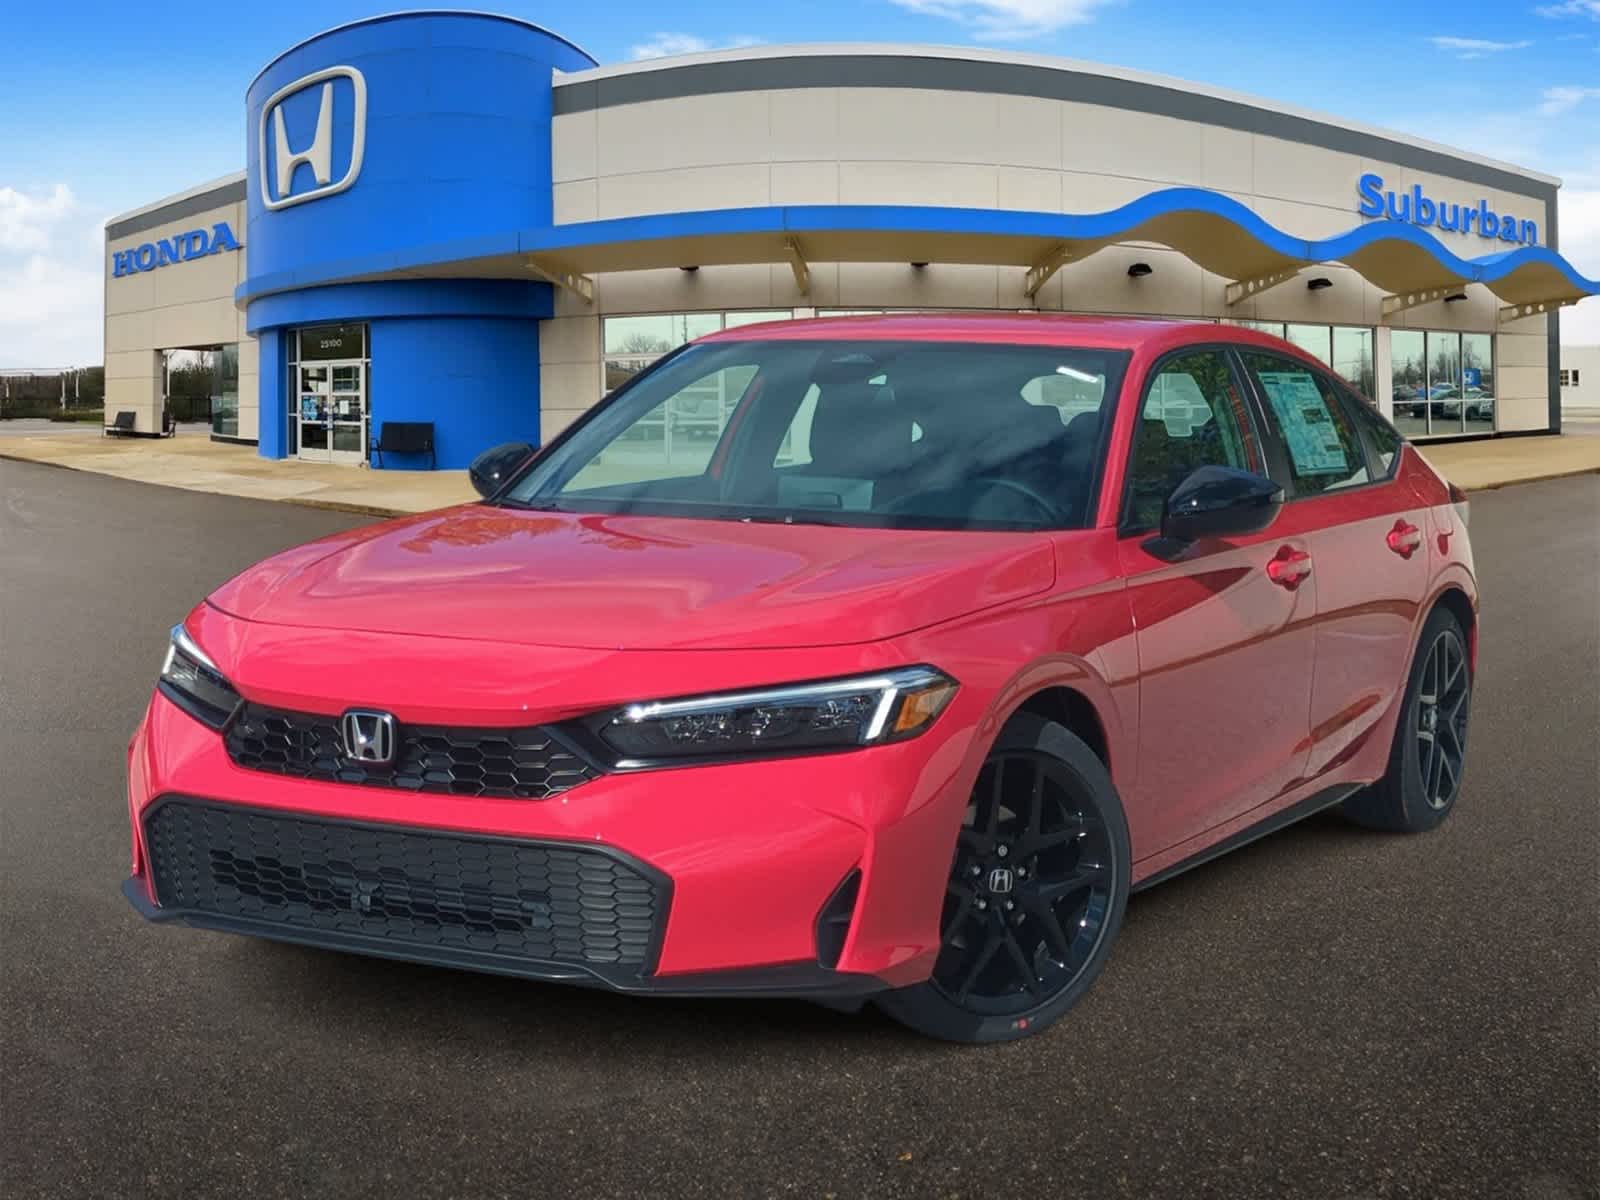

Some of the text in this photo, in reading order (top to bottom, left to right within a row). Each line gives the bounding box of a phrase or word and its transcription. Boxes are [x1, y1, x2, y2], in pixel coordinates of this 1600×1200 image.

[273, 81, 333, 197] H
[1358, 173, 1538, 246] Suburban
[112, 221, 239, 278] HONDA
